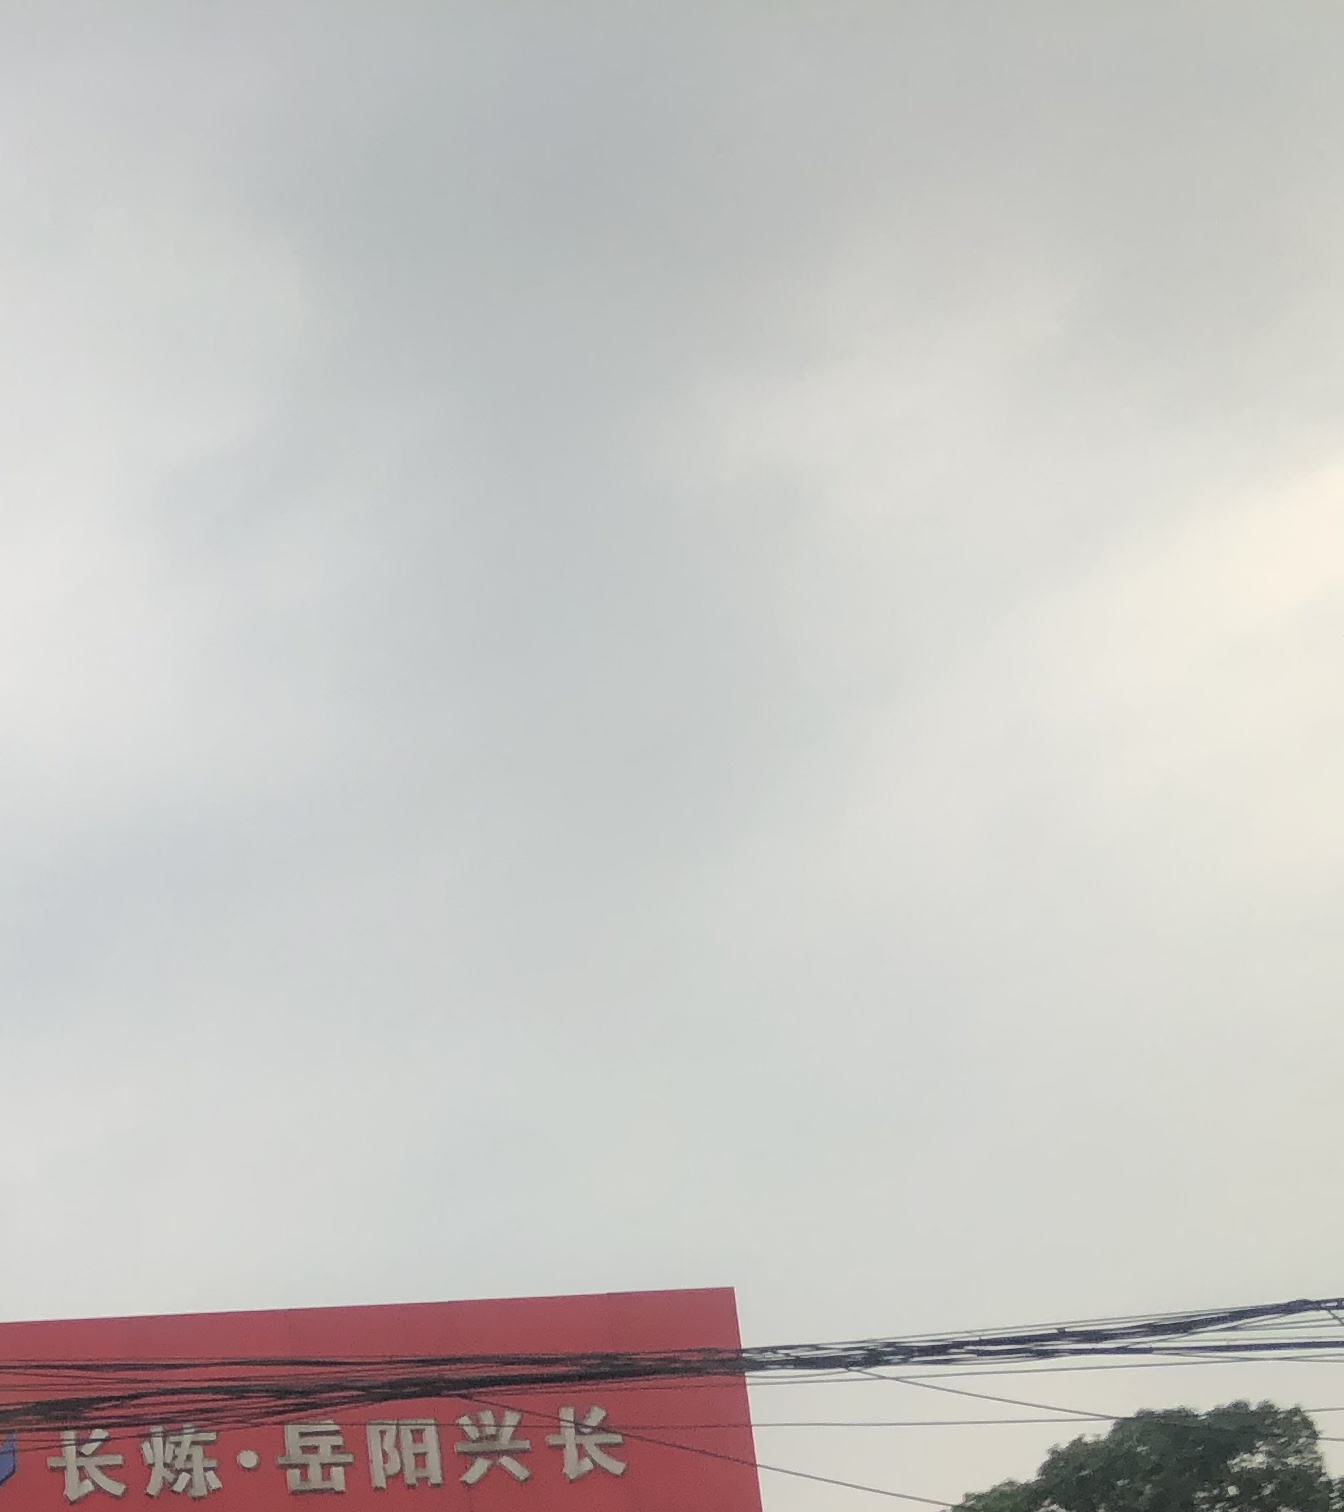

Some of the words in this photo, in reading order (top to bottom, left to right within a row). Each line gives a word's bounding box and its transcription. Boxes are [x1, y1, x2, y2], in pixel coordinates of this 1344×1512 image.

[46, 1405, 628, 1502] 长炼·岳阳兴长
